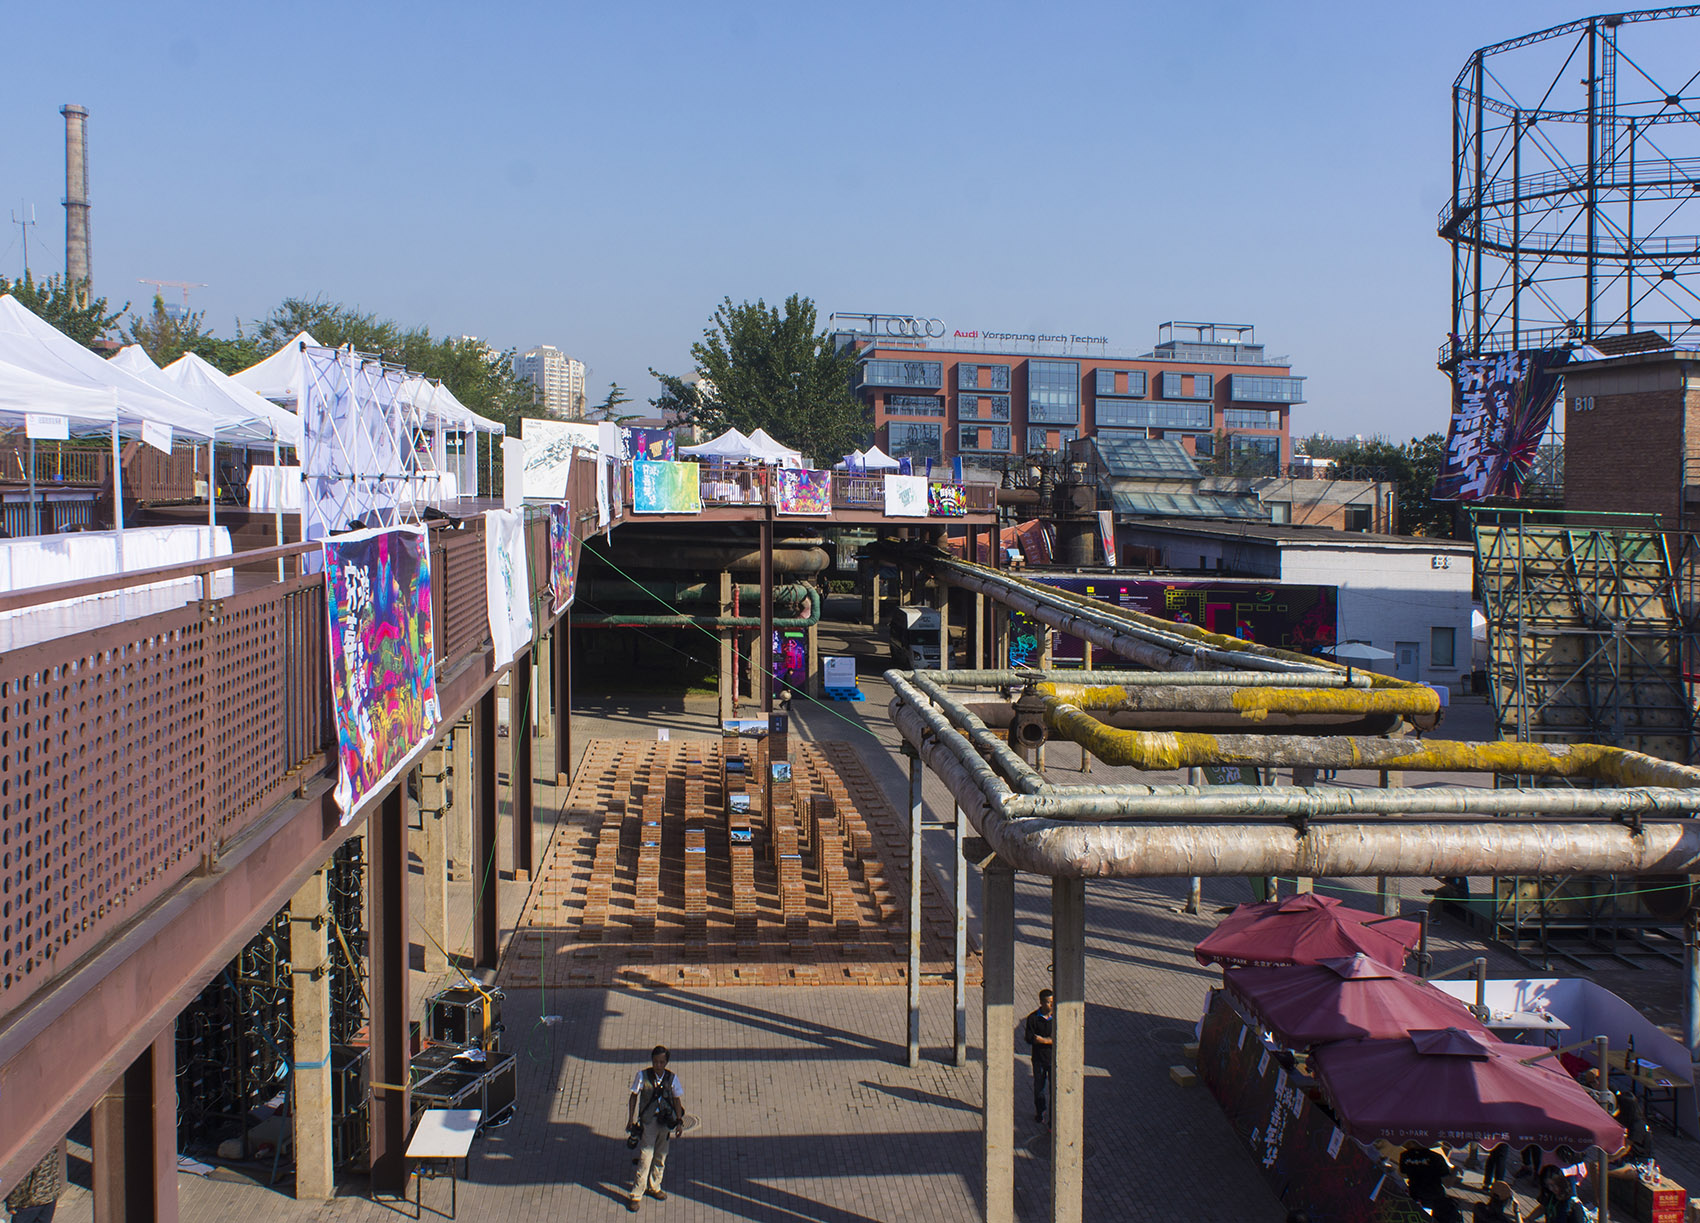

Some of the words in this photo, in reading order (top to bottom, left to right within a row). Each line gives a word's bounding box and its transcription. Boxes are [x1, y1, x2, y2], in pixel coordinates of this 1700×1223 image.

[953, 329, 979, 339] Audi
[982, 330, 1036, 343] Vorsprung
[1038, 333, 1067, 343] durch
[1070, 334, 1109, 345] Technik
[1575, 396, 1595, 412] B10
[1380, 1128, 1394, 1137] 751
